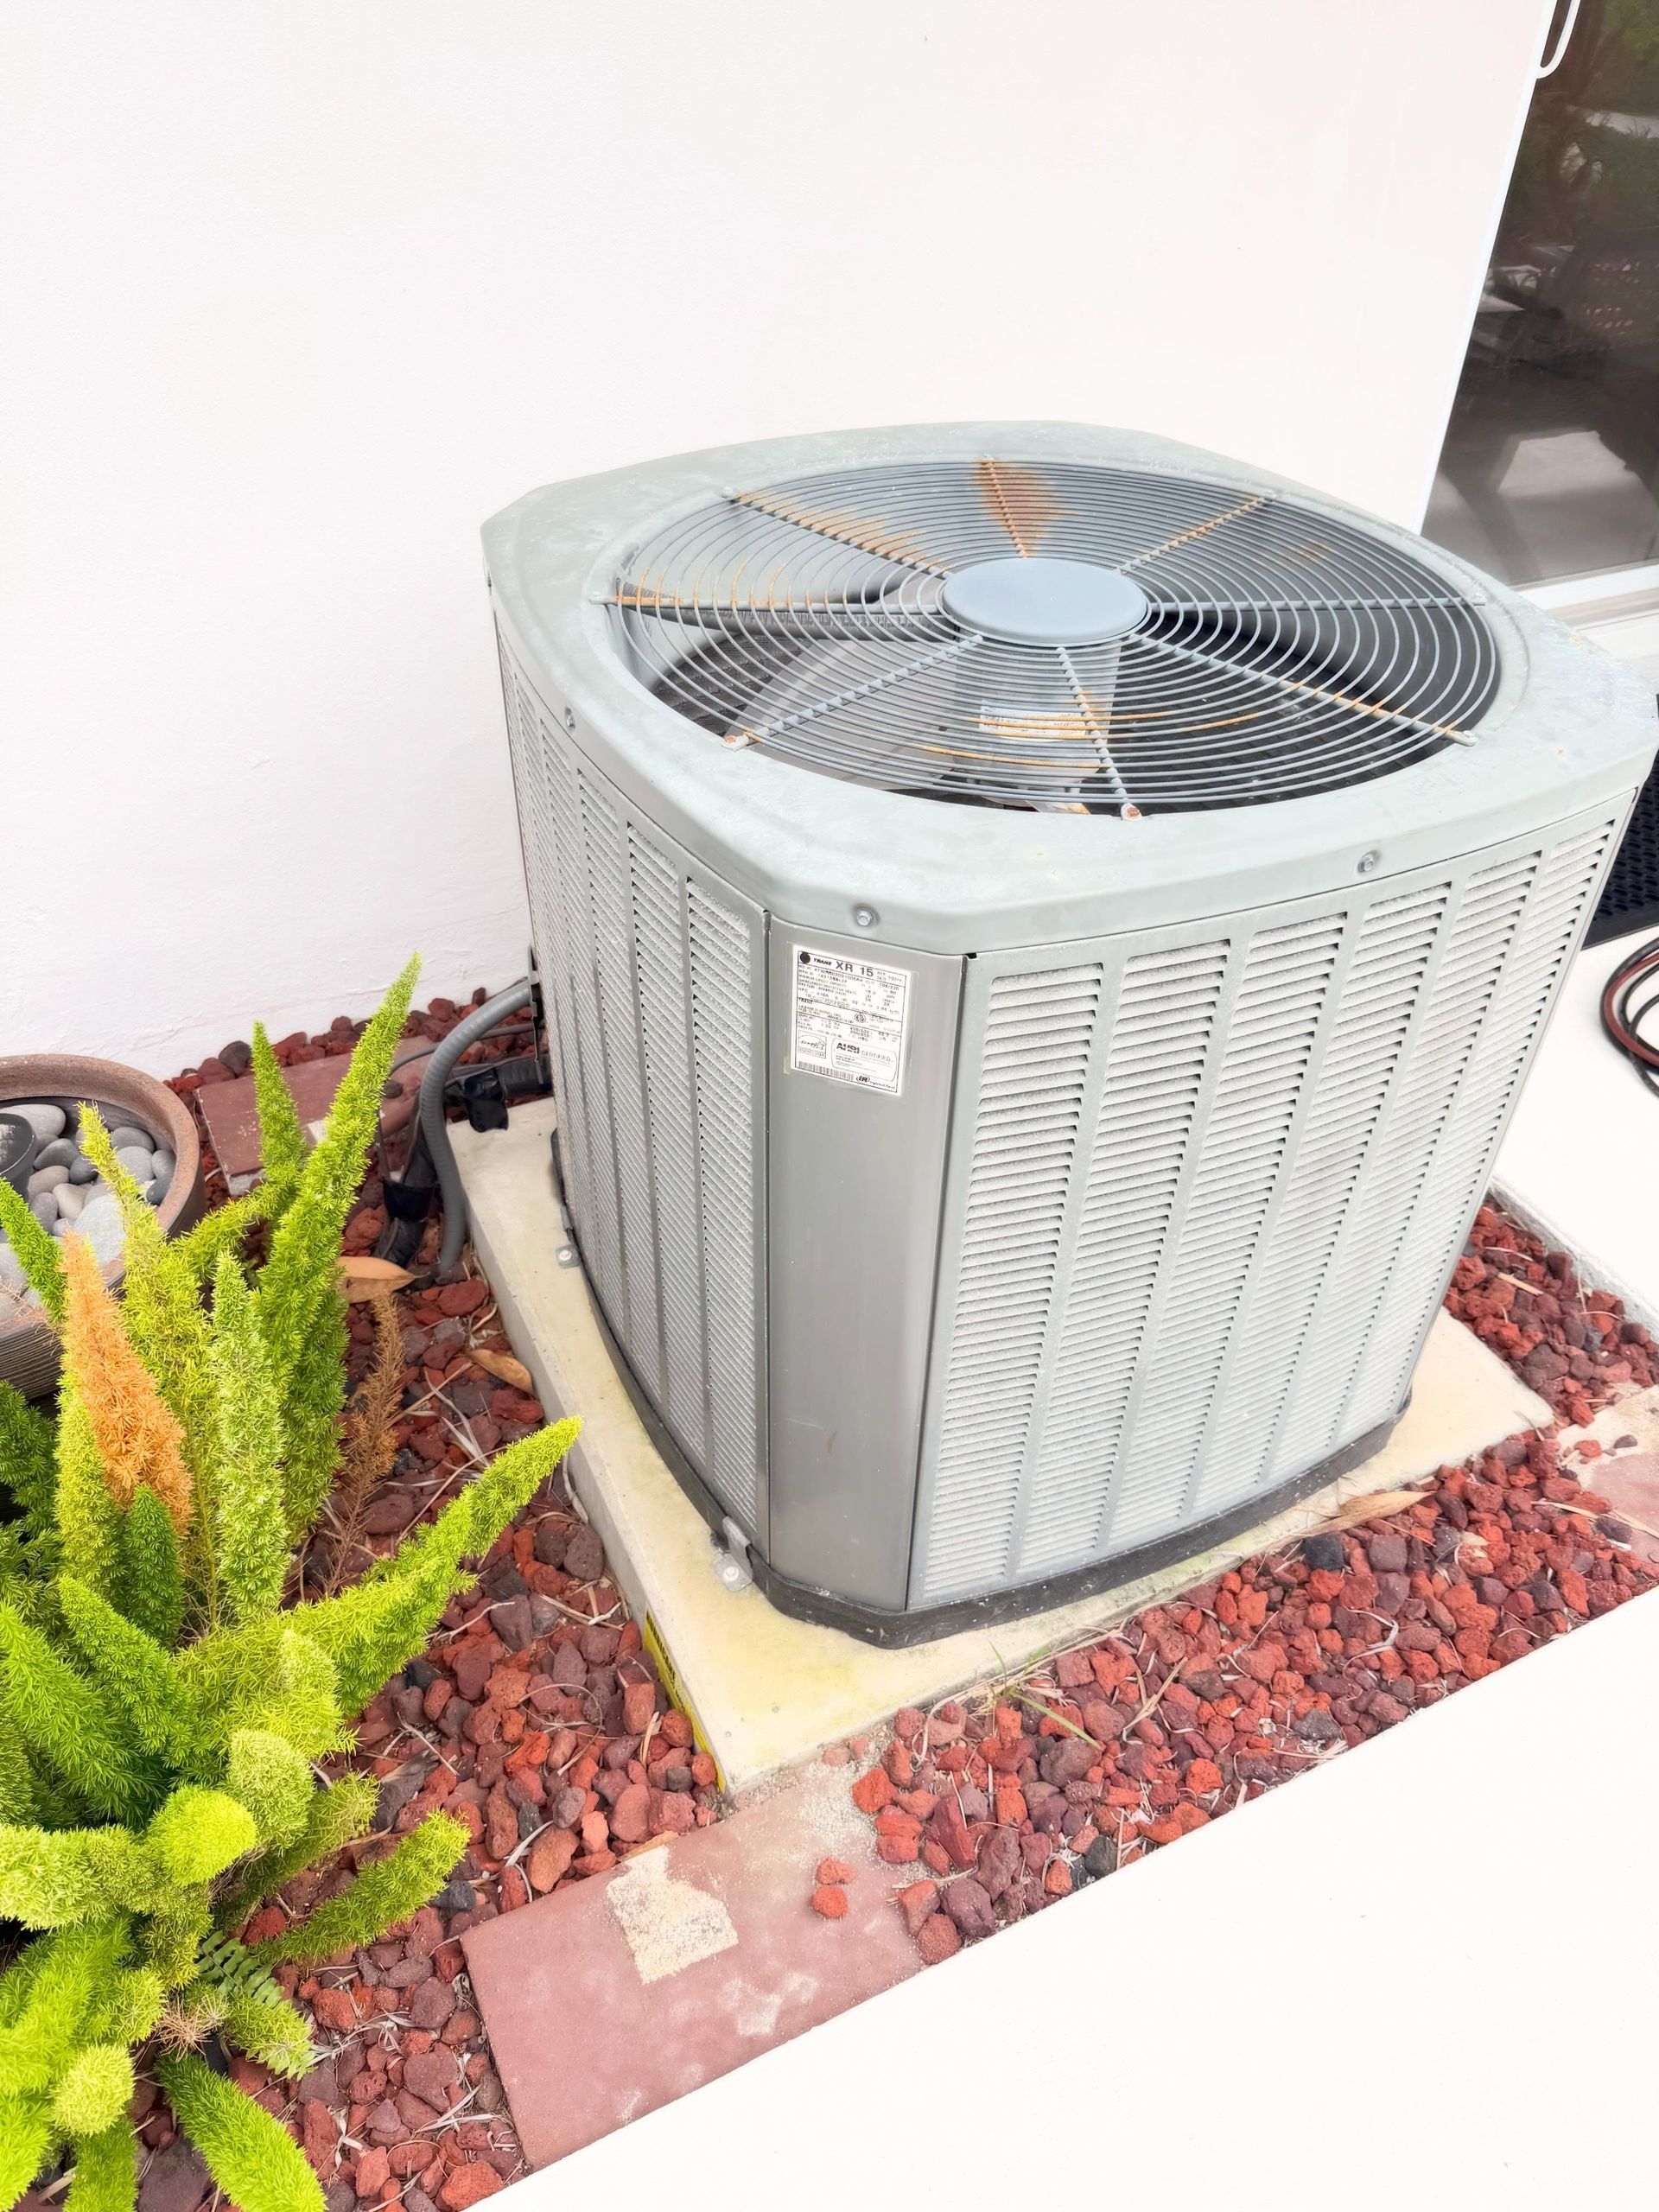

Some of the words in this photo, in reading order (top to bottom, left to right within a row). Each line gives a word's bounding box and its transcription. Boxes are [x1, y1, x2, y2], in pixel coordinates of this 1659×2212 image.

[814, 957, 832, 966] TRANE
[836, 961, 854, 973] XR
[860, 966, 874, 977] 15
